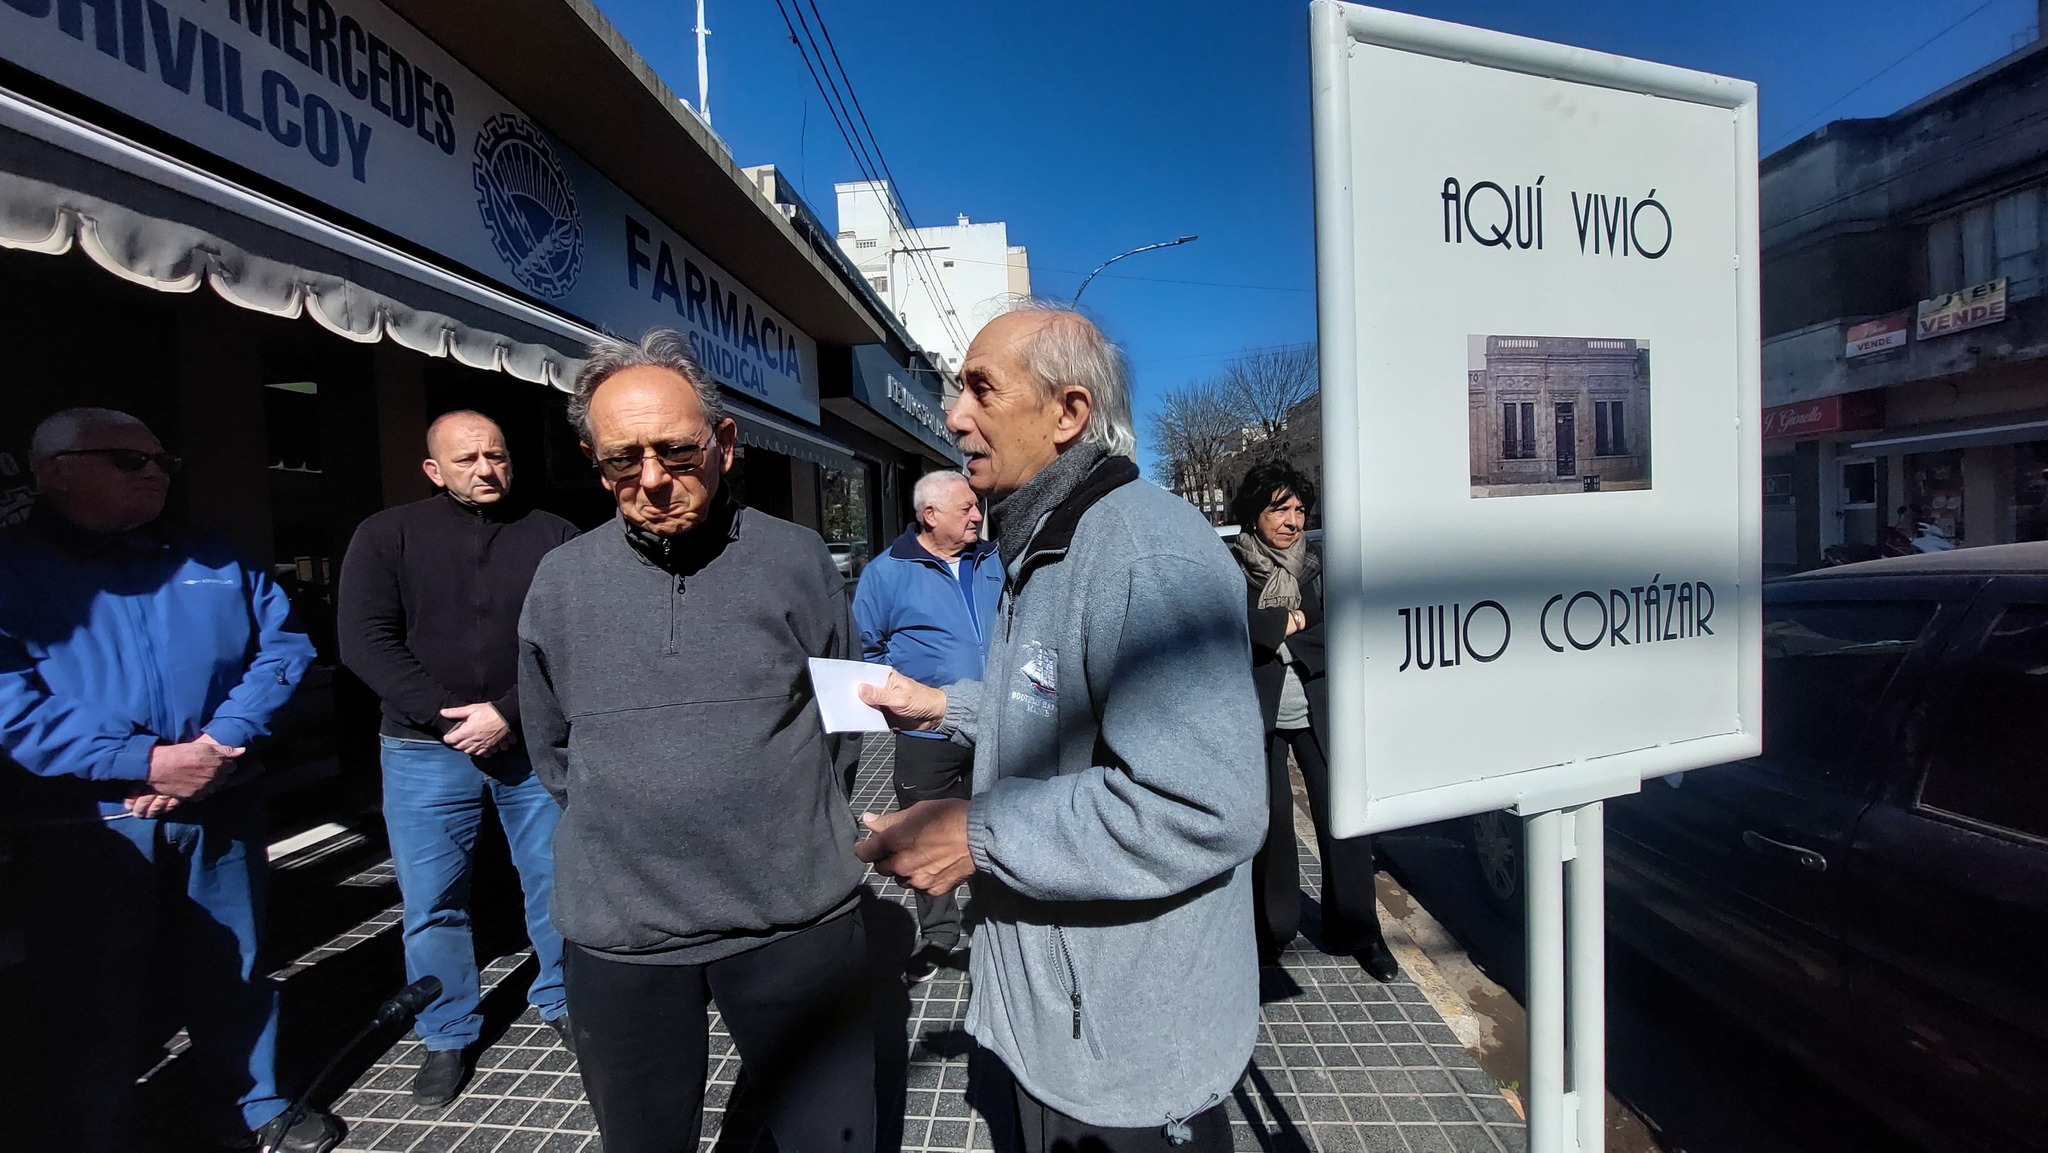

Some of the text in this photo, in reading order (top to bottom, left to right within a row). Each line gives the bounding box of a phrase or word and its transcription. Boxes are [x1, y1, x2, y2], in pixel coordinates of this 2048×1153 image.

[0, 0, 373, 184] HIVILCOY
[1440, 174, 1673, 260] AQUÍ VIVIÓ
[625, 214, 802, 385] FARMACIA
[1919, 299, 2005, 333] VENDE
[688, 329, 769, 397] SINDICAL
[1857, 335, 1893, 351] VENDE
[1397, 572, 1716, 673] JULIO CORTÁZAR
